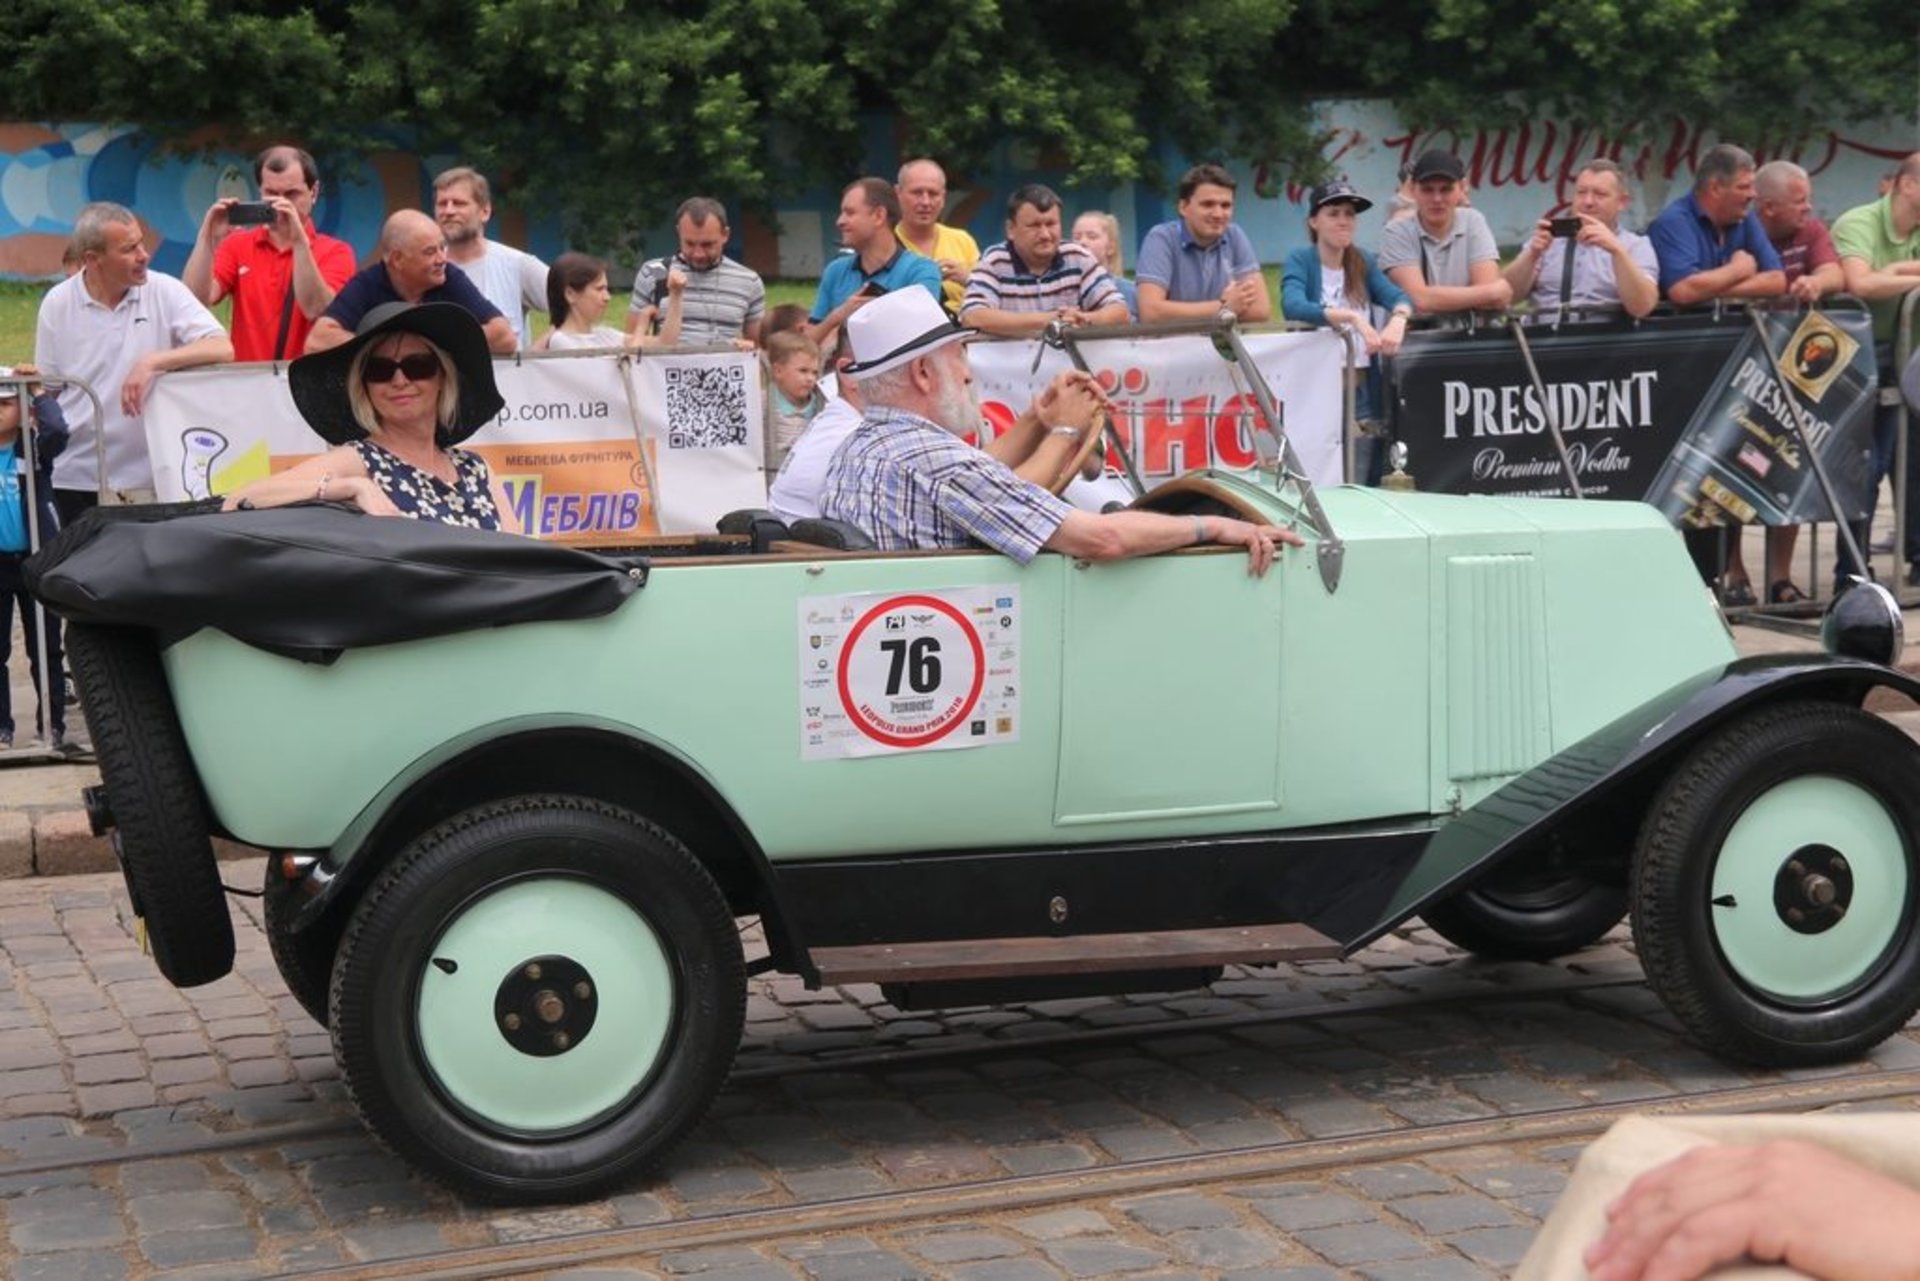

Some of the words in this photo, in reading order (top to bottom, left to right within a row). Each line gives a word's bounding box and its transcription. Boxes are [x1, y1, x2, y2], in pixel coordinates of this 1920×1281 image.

[1443, 371, 1658, 438] PRESIDENT
[505, 452, 567, 467] МЕБЛЕВА
[569, 451, 634, 465] ФУРНІТУРА
[1472, 447, 1562, 481] Premium
[1566, 437, 1631, 475] Vodka
[880, 636, 942, 696] 76
[860, 704, 895, 733] LEOPOLIS
[896, 723, 925, 734] GRAND
[926, 715, 946, 731] PRIX
